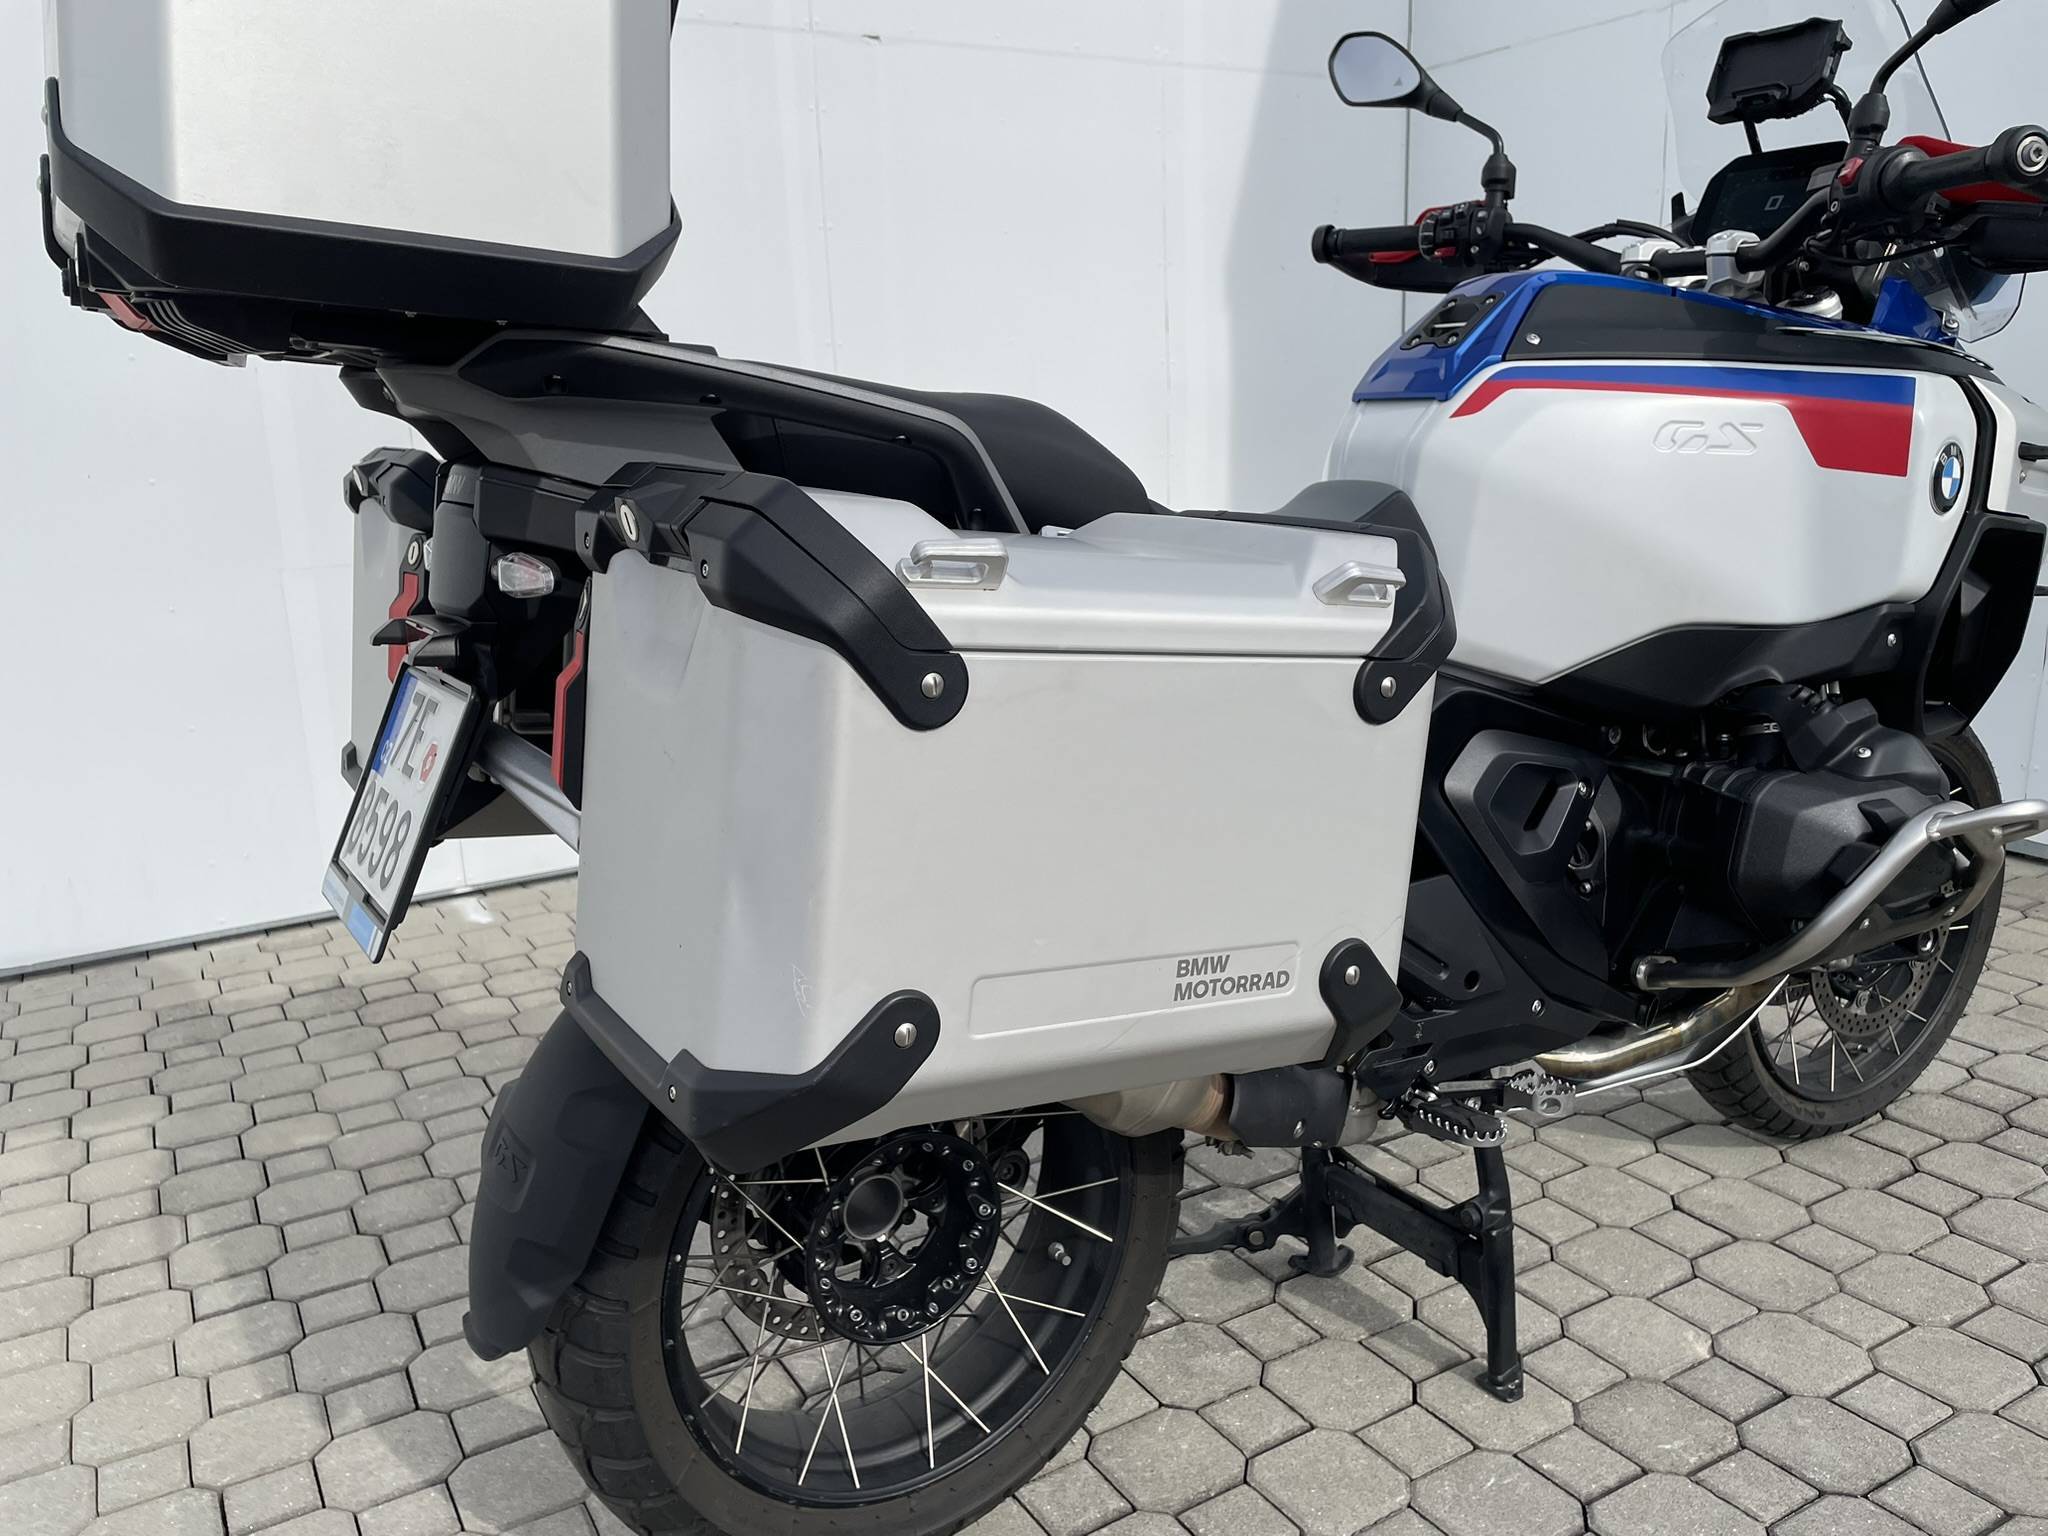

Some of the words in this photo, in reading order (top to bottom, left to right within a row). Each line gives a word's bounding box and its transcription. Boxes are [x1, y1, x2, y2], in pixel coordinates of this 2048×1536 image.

[1652, 419, 1764, 455] GS
[390, 692, 439, 779] 7E
[345, 782, 412, 889] 8598
[1176, 954, 1231, 978] BMW
[1173, 970, 1290, 1001] MOTORRAD
